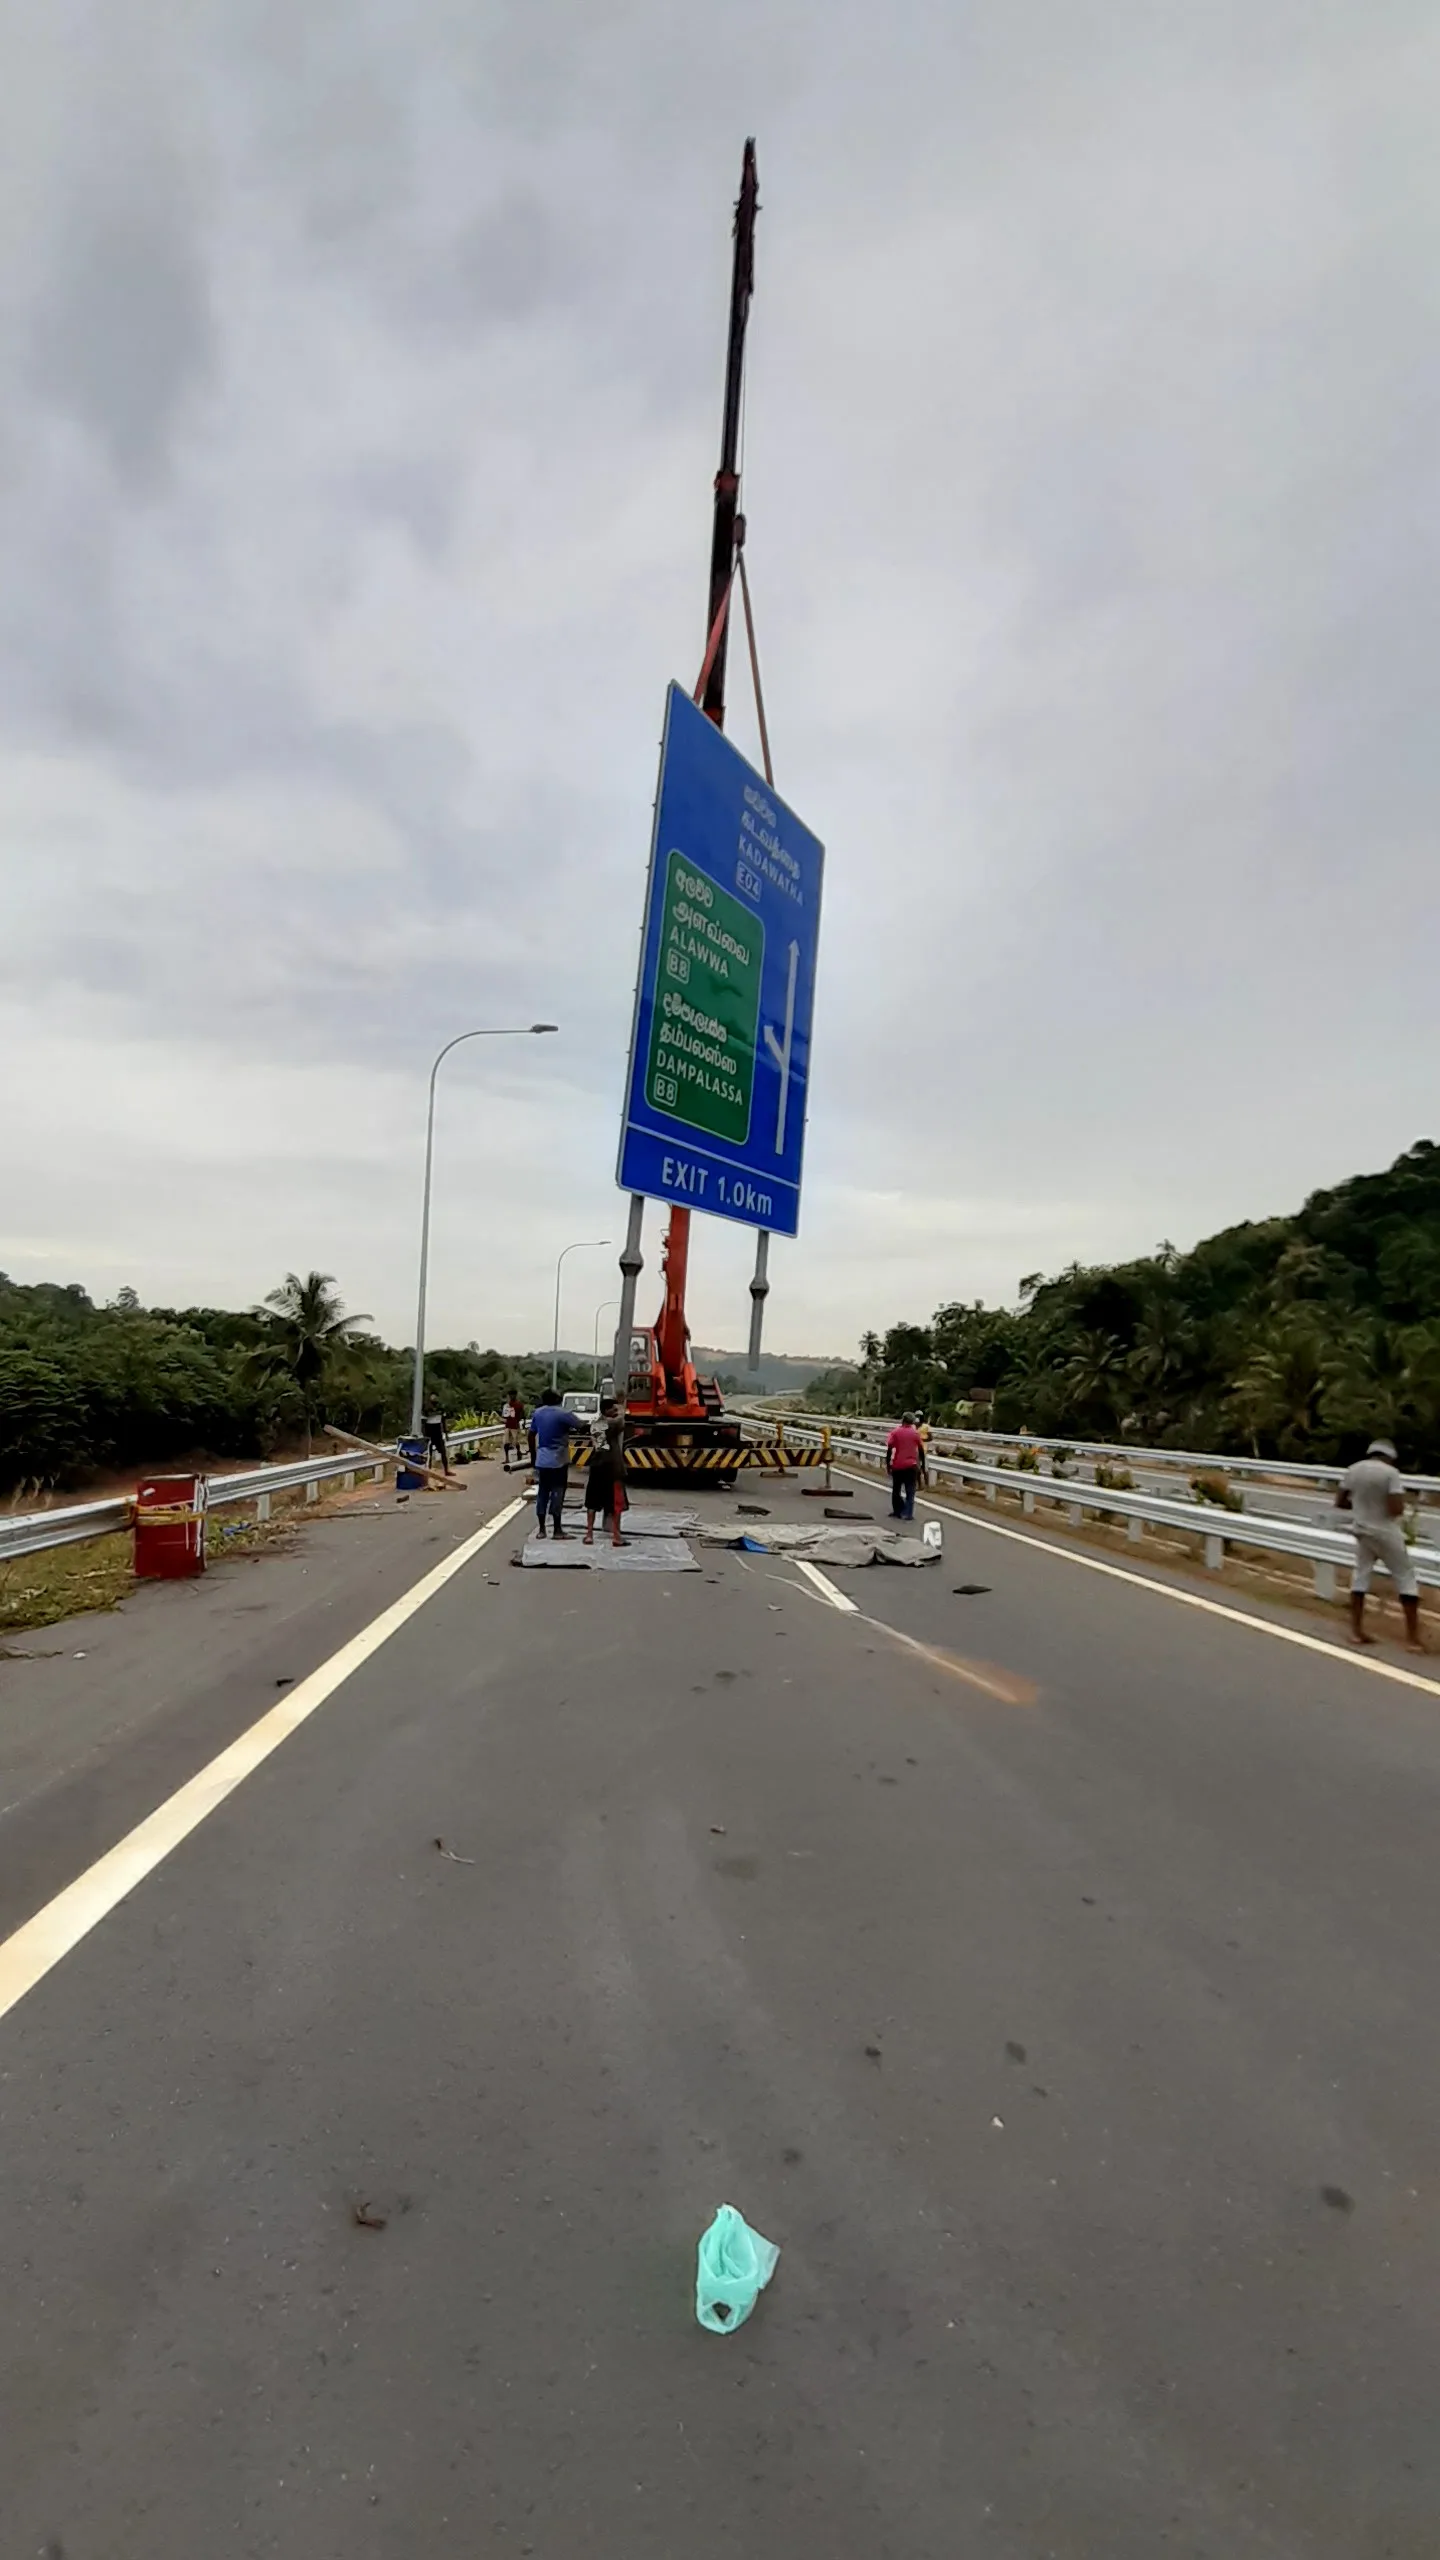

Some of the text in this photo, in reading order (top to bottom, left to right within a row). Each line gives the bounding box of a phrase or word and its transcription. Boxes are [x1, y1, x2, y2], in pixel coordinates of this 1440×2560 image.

[738, 866, 761, 897] E04
[739, 833, 804, 907] KADAWATHA
[669, 953, 688, 978] B8
[670, 925, 729, 978] ALAWWA
[656, 1049, 743, 1106] DAMPALASSA
[656, 1078, 675, 1101] B8
[662, 1156, 772, 1216] EXIT 1.0km
